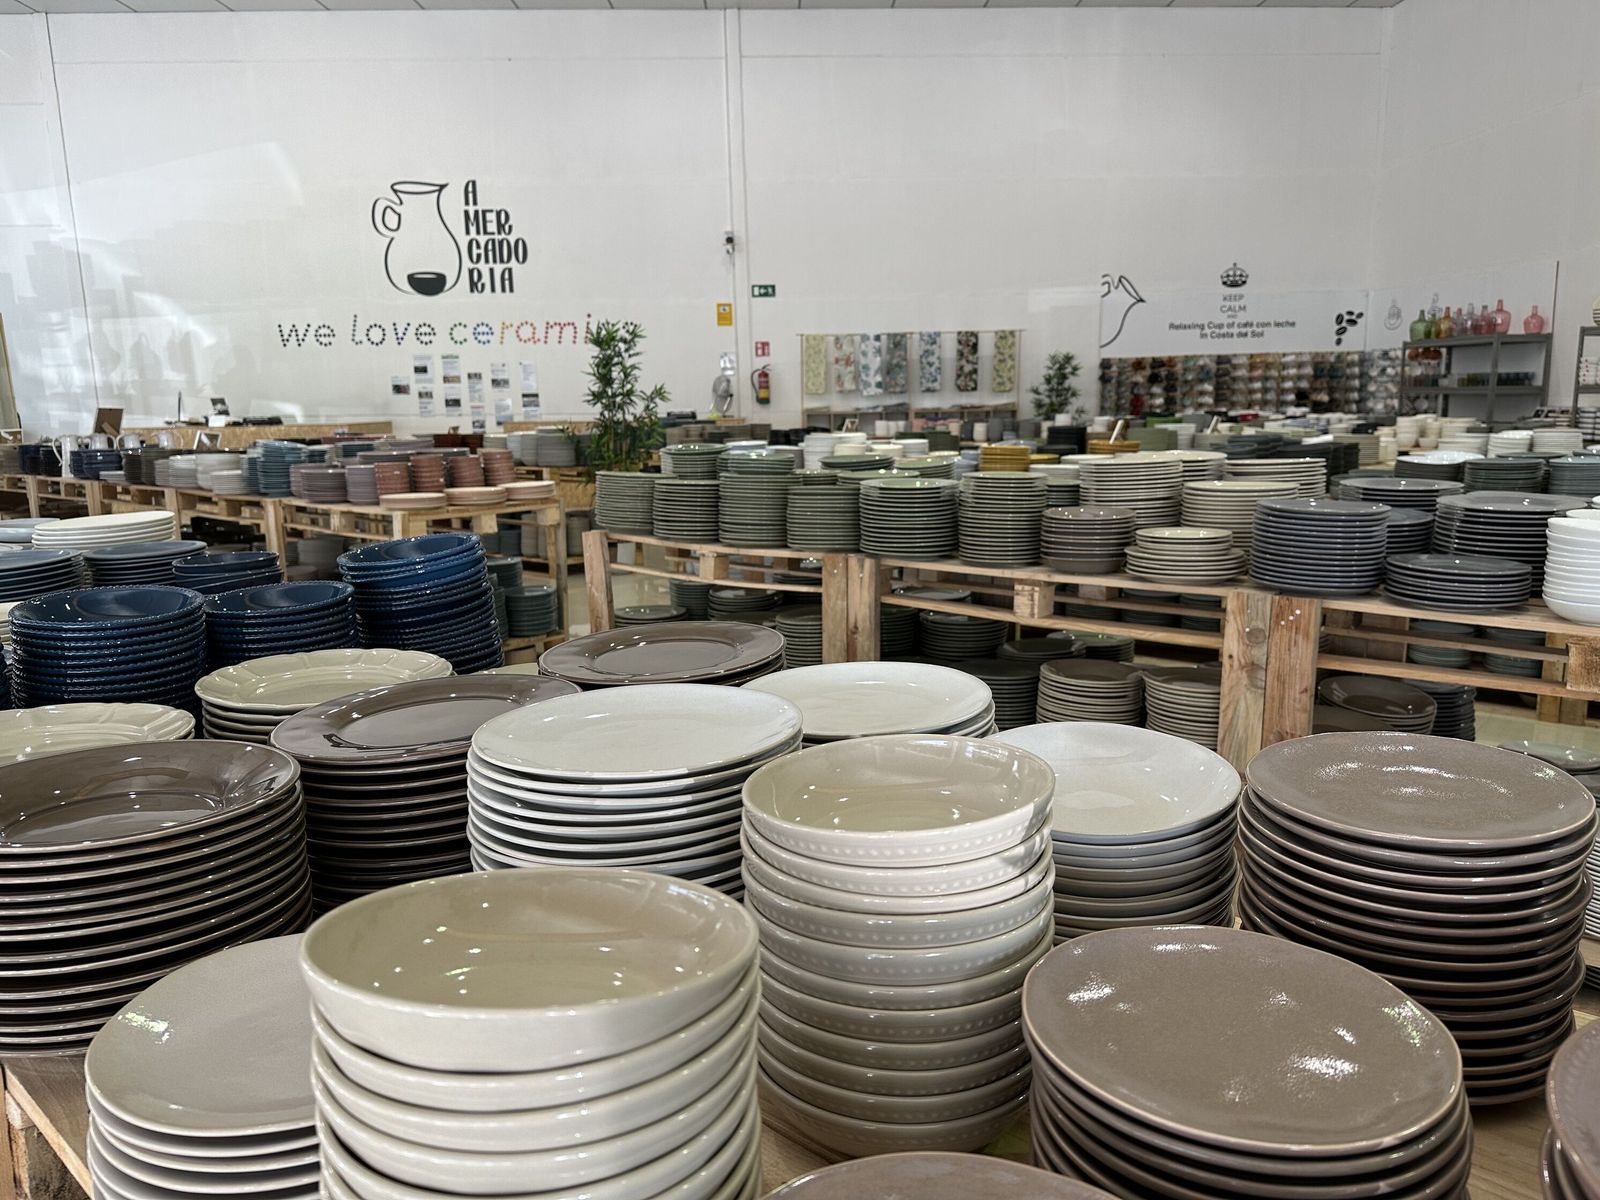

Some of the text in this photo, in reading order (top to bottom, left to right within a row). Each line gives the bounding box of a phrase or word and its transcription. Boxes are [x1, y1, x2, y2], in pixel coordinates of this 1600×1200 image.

[464, 179, 478, 207] A
[464, 208, 513, 236] MER
[467, 237, 528, 265] CADO
[468, 267, 514, 294] RIA
[1220, 304, 1247, 314] CALM
[1222, 294, 1244, 302] KEEP
[278, 323, 336, 347] we
[352, 313, 436, 346] love
[1168, 322, 1206, 331] Relaxing
[1207, 321, 1224, 330] Cup
[1226, 321, 1235, 329] of
[1256, 321, 1272, 329] con
[1273, 320, 1296, 329] leche
[1210, 331, 1234, 340] Costa
[1236, 331, 1248, 339] del
[1250, 330, 1264, 339] Sol
